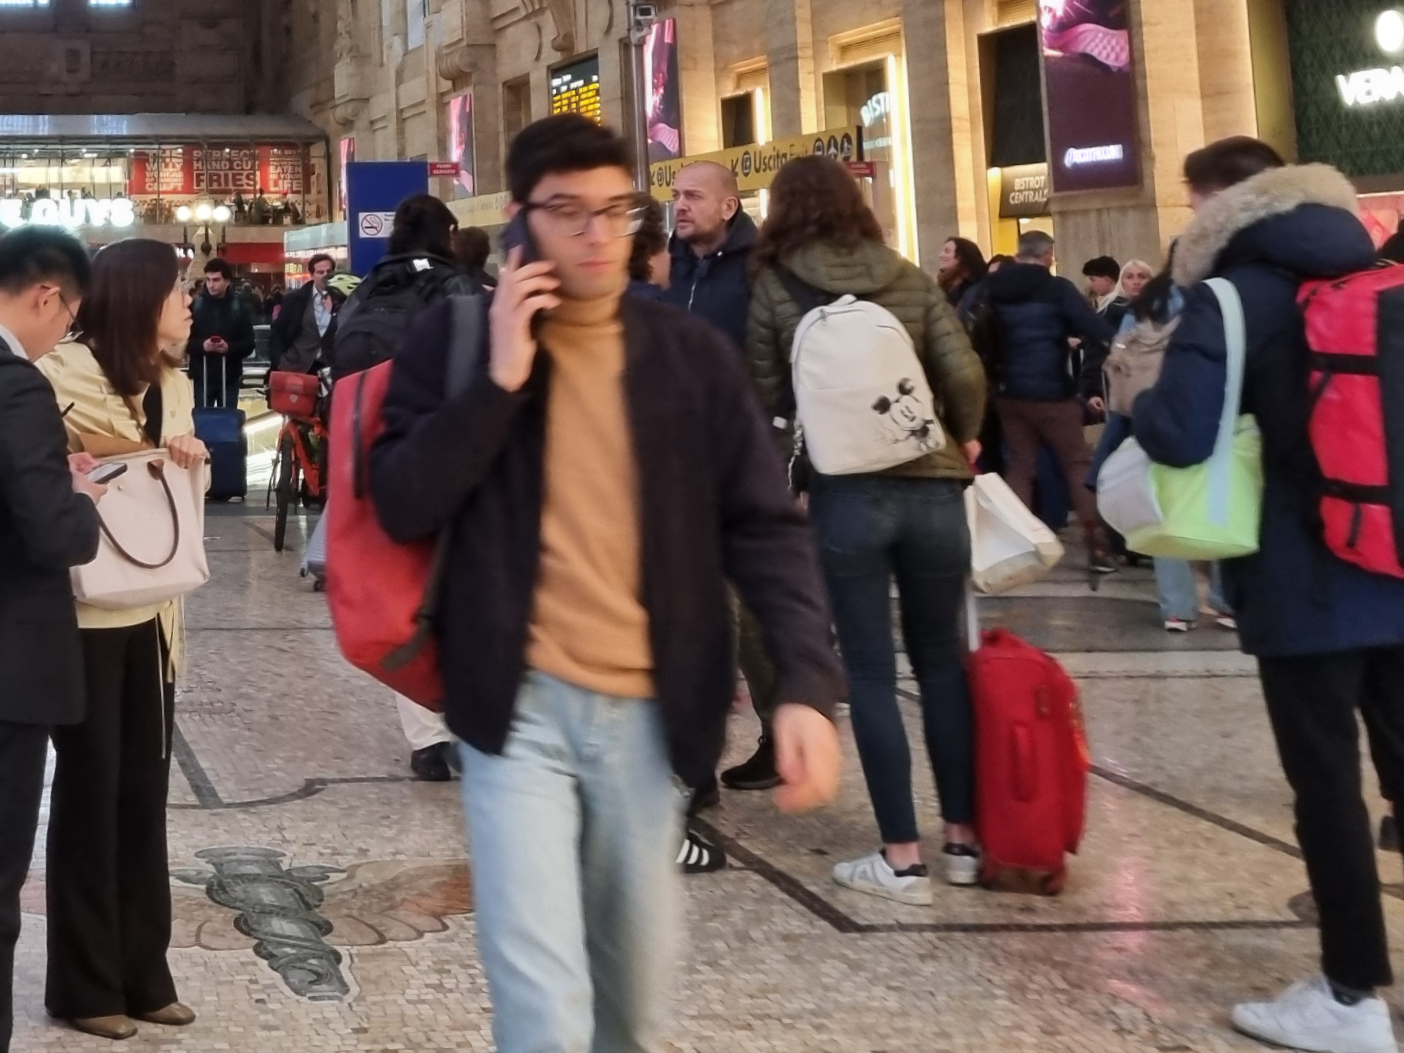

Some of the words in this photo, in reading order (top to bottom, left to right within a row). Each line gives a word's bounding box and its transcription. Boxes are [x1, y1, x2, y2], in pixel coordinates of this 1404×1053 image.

[193, 160, 230, 170] HAND
[233, 160, 260, 170] CUT
[753, 146, 787, 173] Uscita
[269, 165, 302, 173] EATEN
[195, 171, 258, 188] FRIES
[269, 179, 303, 192] LIFE
[1014, 175, 1046, 190] BISTROT
[29, 197, 135, 229] GUYS
